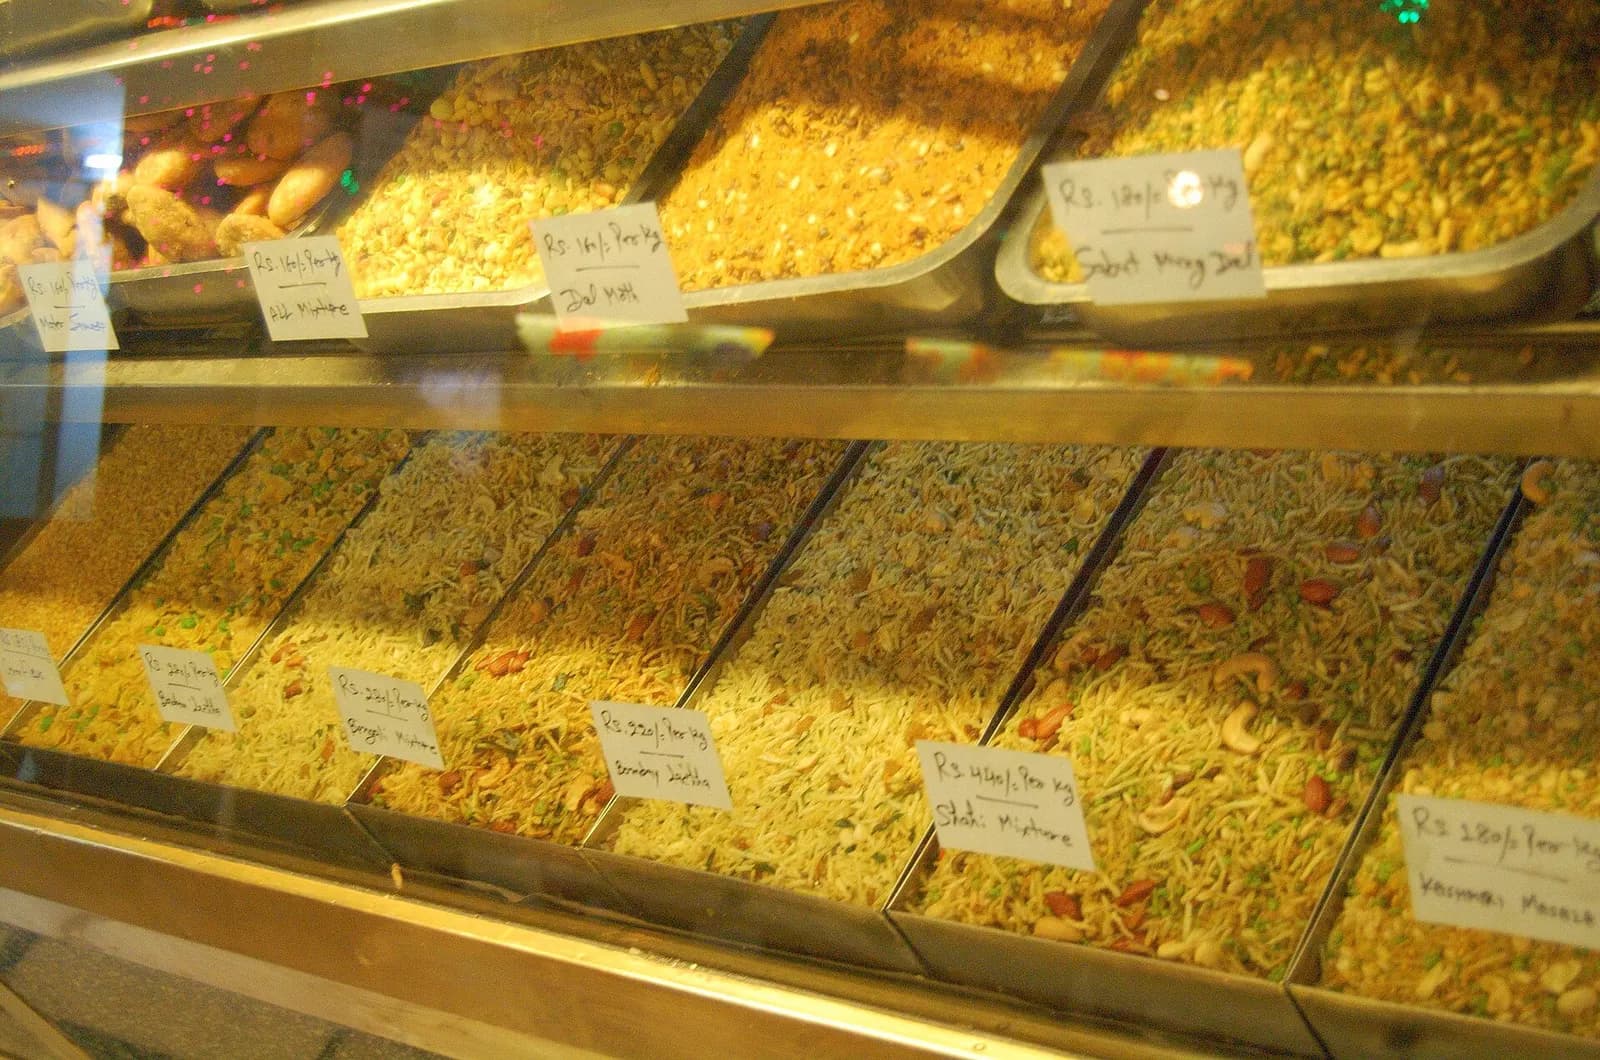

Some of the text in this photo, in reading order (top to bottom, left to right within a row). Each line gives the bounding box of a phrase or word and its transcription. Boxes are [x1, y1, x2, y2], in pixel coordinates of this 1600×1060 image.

[1059, 179, 1102, 214] Rs.
[1209, 241, 1253, 276] Dal
[560, 282, 597, 312] Dal
[1052, 777, 1075, 807] kg
[936, 799, 1073, 847] Shahi Mixture
